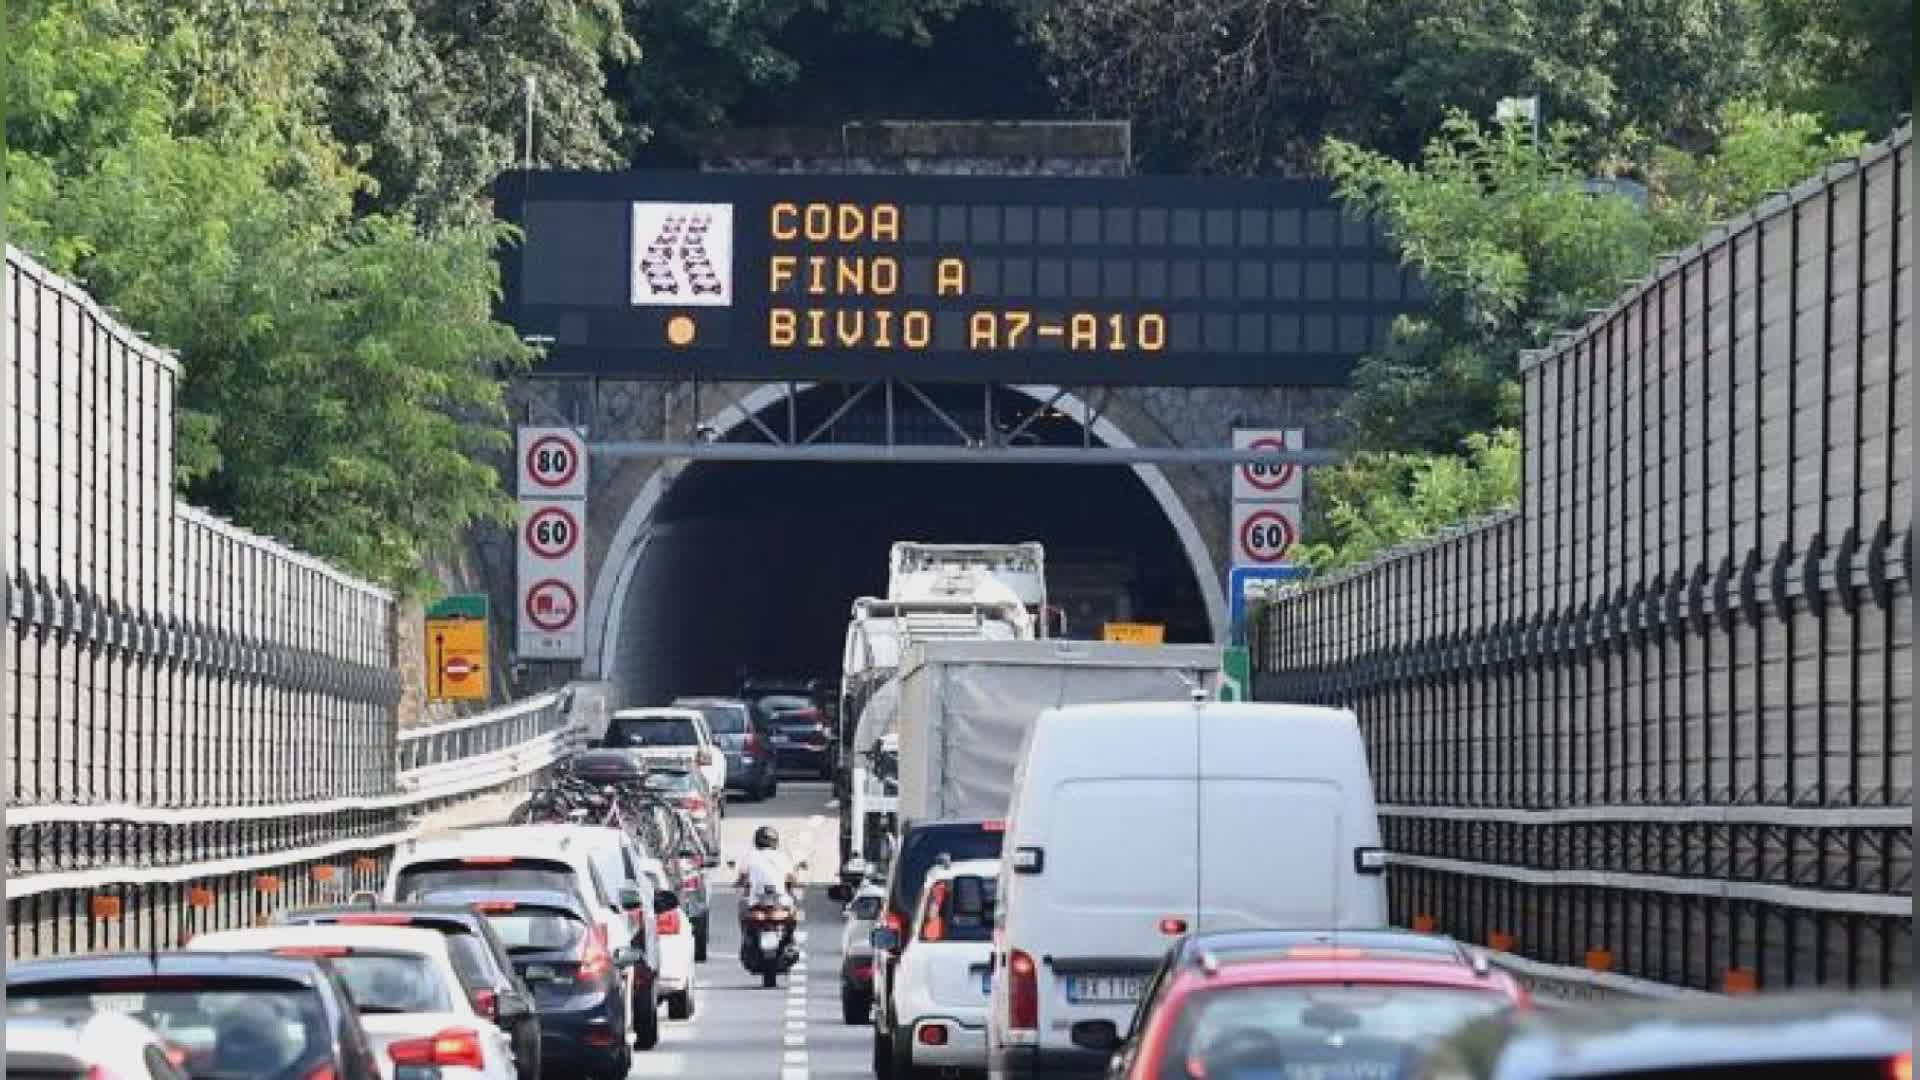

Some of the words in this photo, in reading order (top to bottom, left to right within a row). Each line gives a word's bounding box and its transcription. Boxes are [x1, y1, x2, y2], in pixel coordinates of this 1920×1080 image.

[771, 203, 899, 242] CODA
[769, 256, 898, 295] FINO
[938, 257, 965, 296] A
[769, 308, 931, 349] BIVIO
[969, 310, 1165, 352] A7-A10
[538, 450, 567, 472] 80
[537, 521, 567, 545] 60
[1252, 524, 1282, 548] 60
